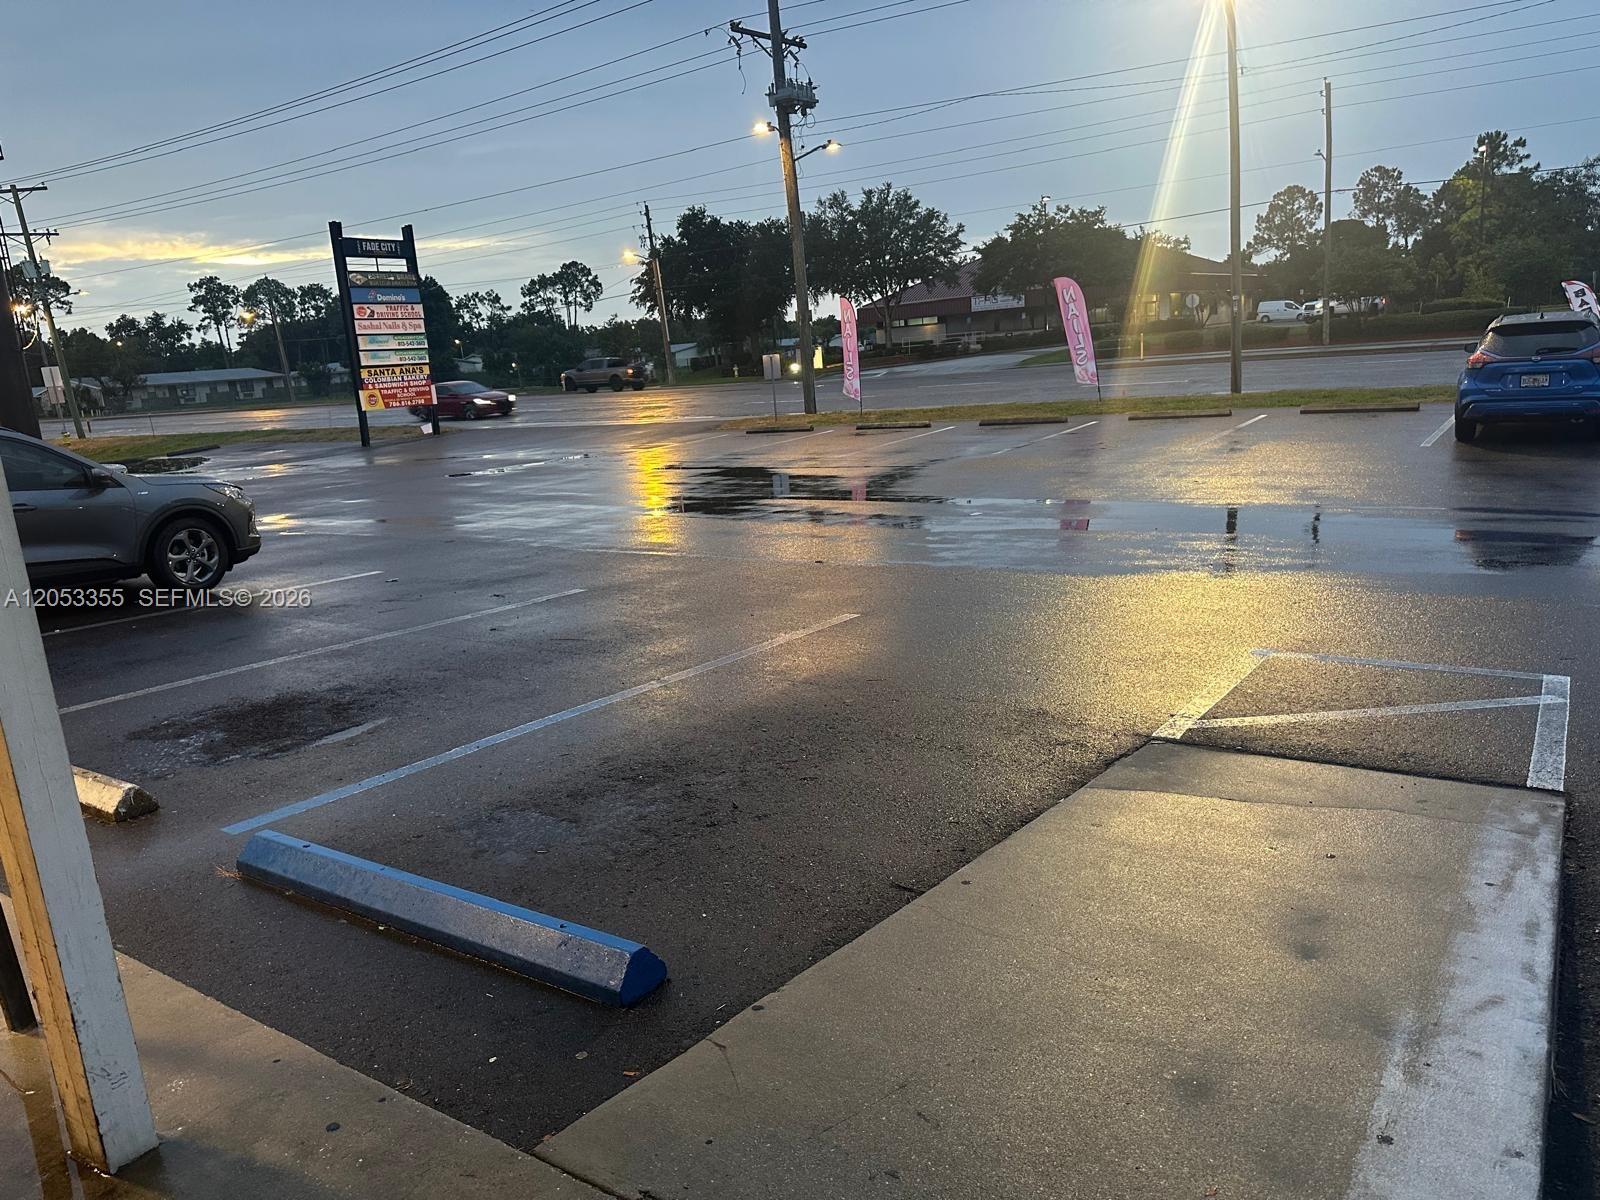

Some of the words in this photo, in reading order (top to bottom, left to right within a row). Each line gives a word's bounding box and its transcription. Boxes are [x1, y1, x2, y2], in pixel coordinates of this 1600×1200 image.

[362, 242, 380, 251] FADE
[380, 242, 396, 252] CITY
[382, 321, 400, 330] Nails
[401, 321, 408, 331] &
[408, 321, 422, 331] Spa
[367, 368, 396, 377] SANTA
[399, 366, 424, 375] ANA'S
[364, 376, 402, 384] COLOMBIAN
